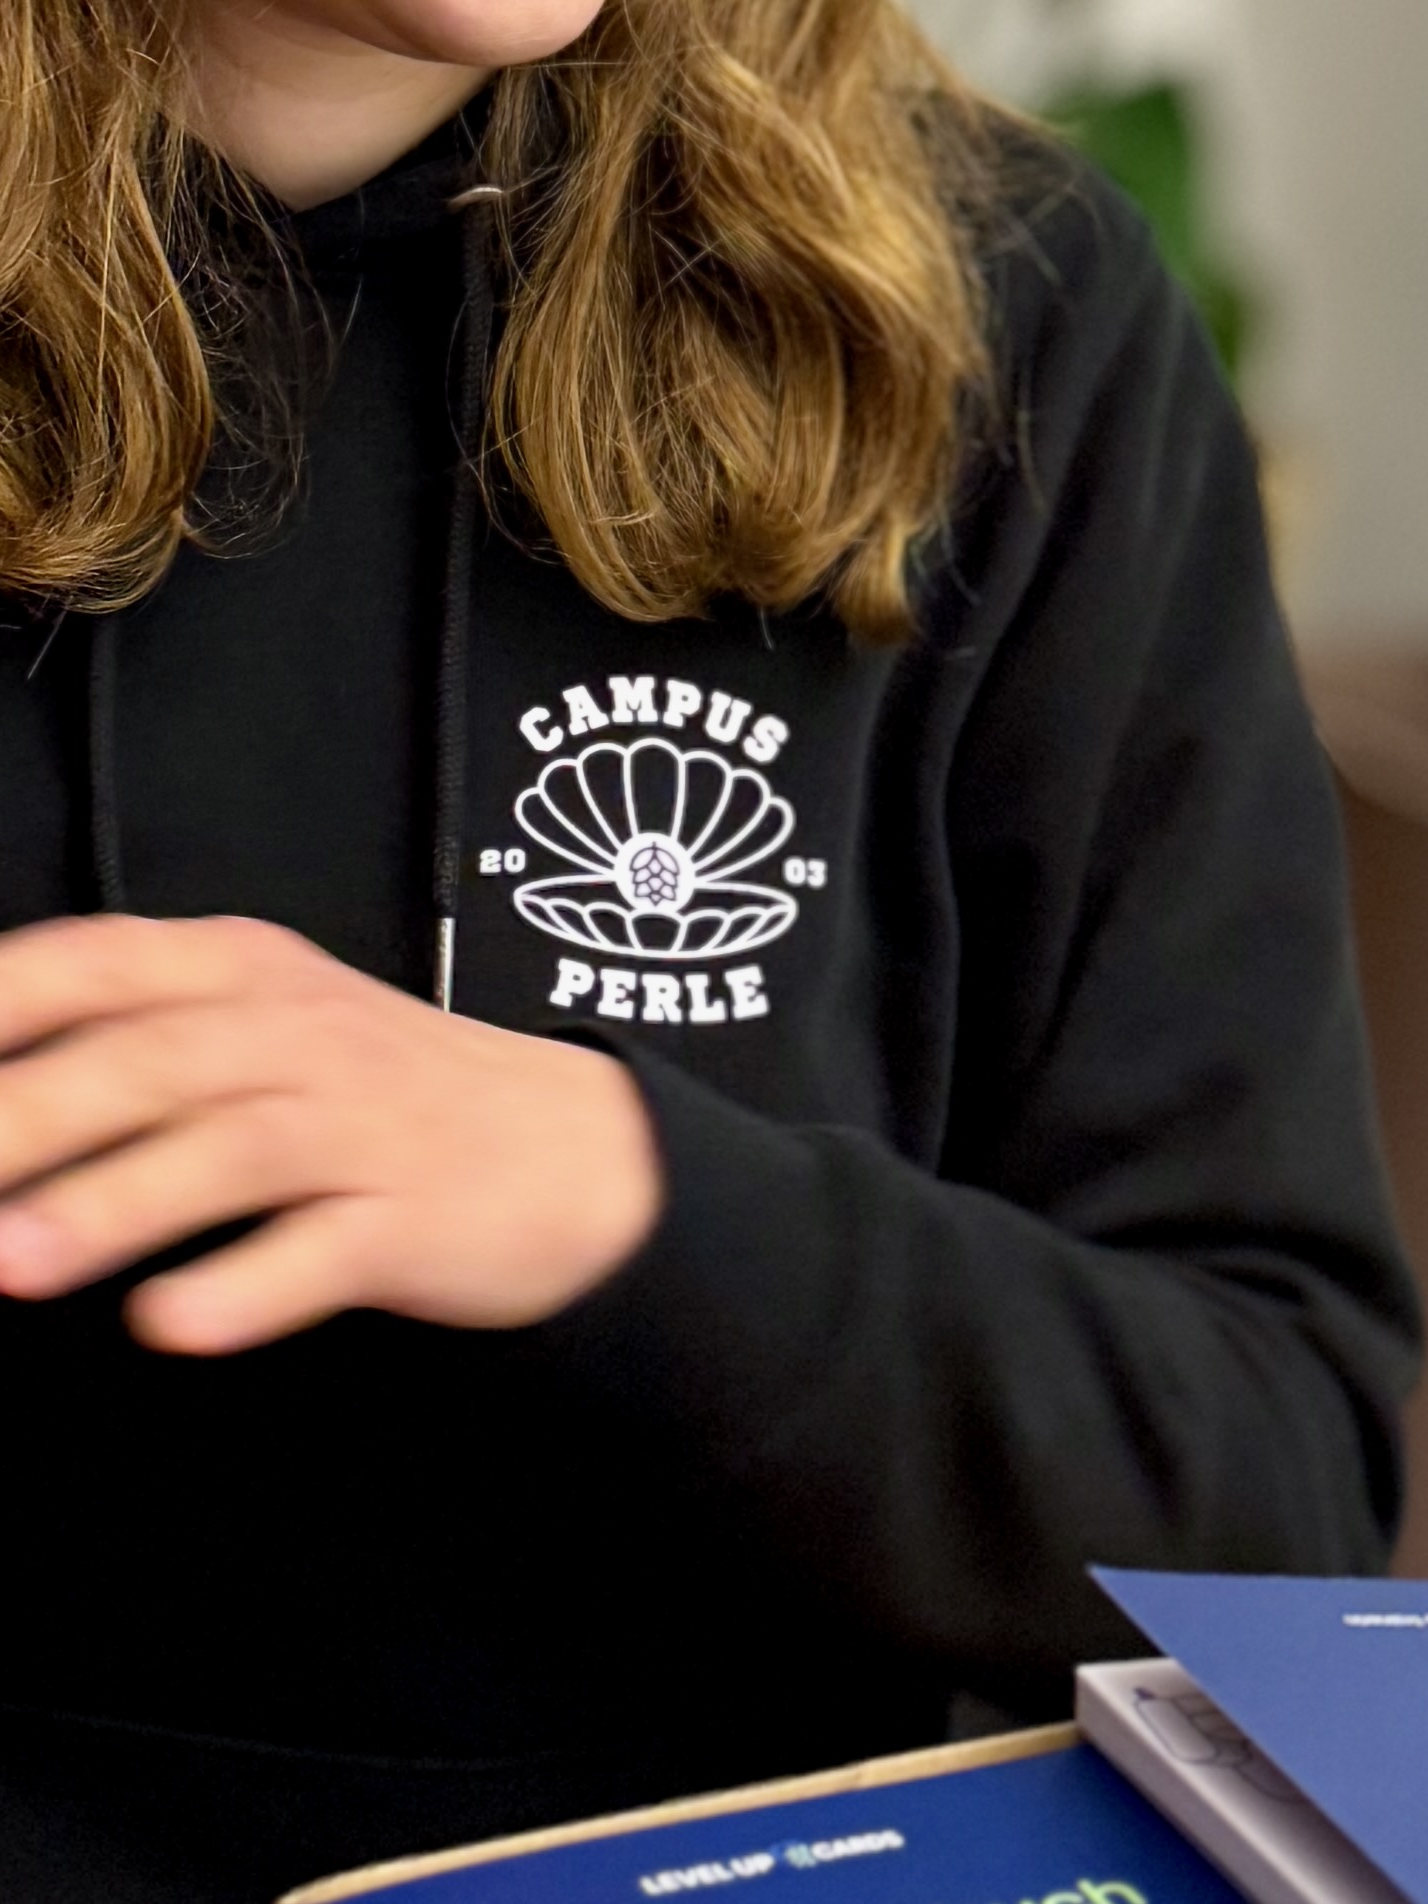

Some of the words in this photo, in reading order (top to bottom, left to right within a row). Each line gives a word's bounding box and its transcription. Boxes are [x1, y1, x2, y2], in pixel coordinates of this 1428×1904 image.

[519, 675, 790, 763] CAMPUS
[478, 847, 527, 874] 20
[783, 857, 827, 889] 03
[549, 958, 769, 1024] PERLE
[639, 1862, 734, 1896] LEVEL
[729, 1852, 774, 1878] UP
